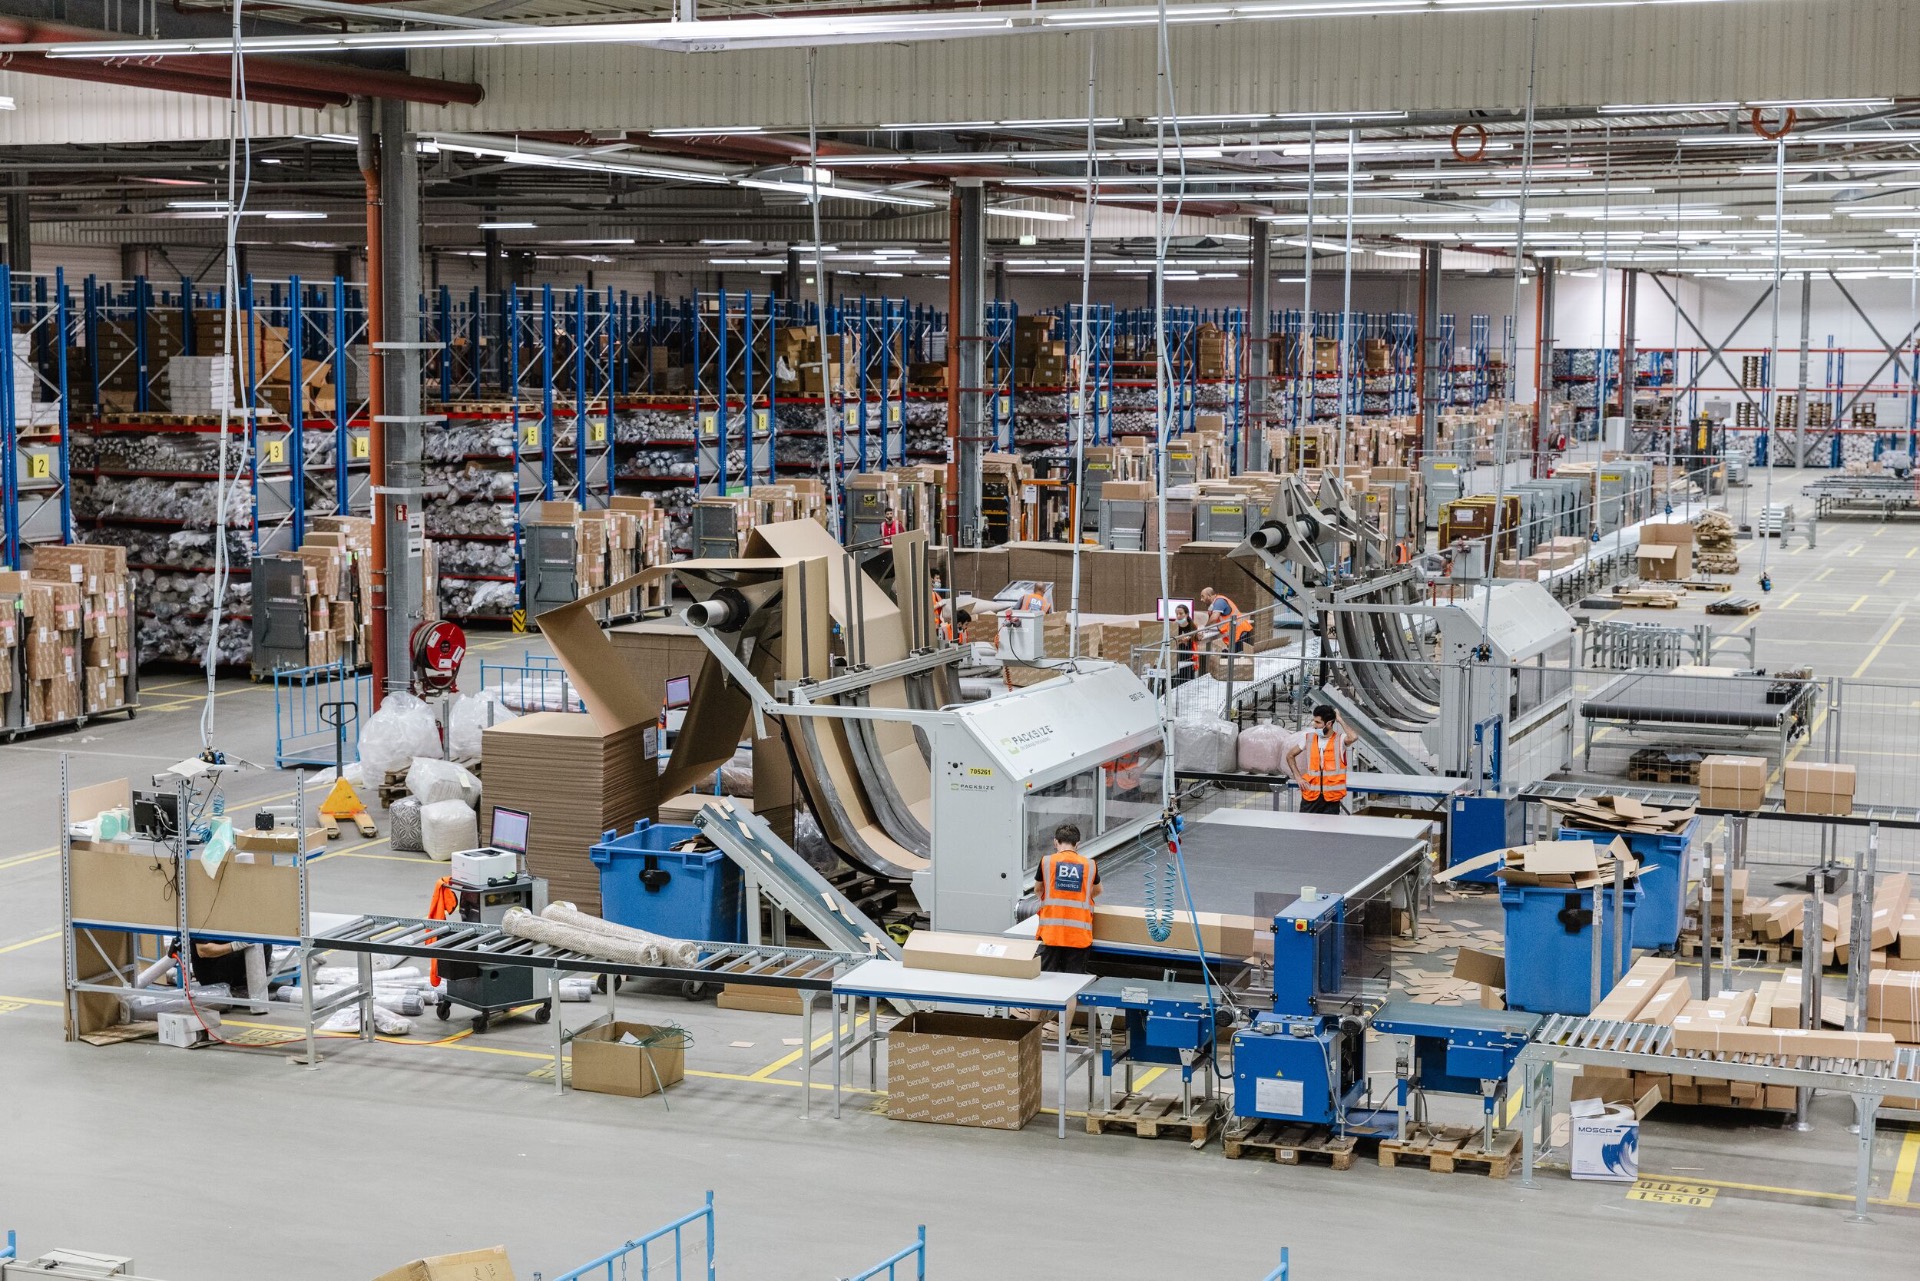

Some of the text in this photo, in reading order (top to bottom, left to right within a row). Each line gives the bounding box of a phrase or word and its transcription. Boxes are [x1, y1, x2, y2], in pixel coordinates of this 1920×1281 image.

[274, 445, 280, 458] 3
[360, 441, 365, 453] 4
[38, 459, 45, 473] 2
[1031, 598, 1042, 606] BA
[1011, 725, 1054, 745] PACKSIZE
[1059, 865, 1080, 879] BA
[888, 1042, 904, 1050] enuta
[907, 1044, 929, 1053] benuta
[932, 1046, 954, 1055] benuta
[957, 1048, 979, 1058] benuta
[982, 1051, 1005, 1060] benuta
[888, 1059, 904, 1067] enuta
[907, 1060, 929, 1070] benuta
[932, 1063, 954, 1072] benuta
[957, 1065, 979, 1074] benuta
[982, 1067, 1005, 1076] benuta
[888, 1075, 904, 1083] enuta
[907, 1077, 929, 1086] benuta
[931, 1080, 954, 1089] benuta
[957, 1081, 979, 1091] benuta
[982, 1084, 1005, 1093] benuta
[888, 1091, 904, 1099] enuta
[906, 1094, 929, 1103] benuta
[931, 1096, 954, 1105] benuta
[956, 1098, 979, 1107] benuta
[982, 1100, 1005, 1109] benuta
[888, 1108, 904, 1116] enuta
[906, 1110, 929, 1119] benuta
[931, 1112, 954, 1121] benuta
[956, 1114, 979, 1124] benuta
[982, 1117, 1004, 1126] benuta
[1640, 1181, 1710, 1195] 0049
[1639, 1192, 1702, 1205] 1550
